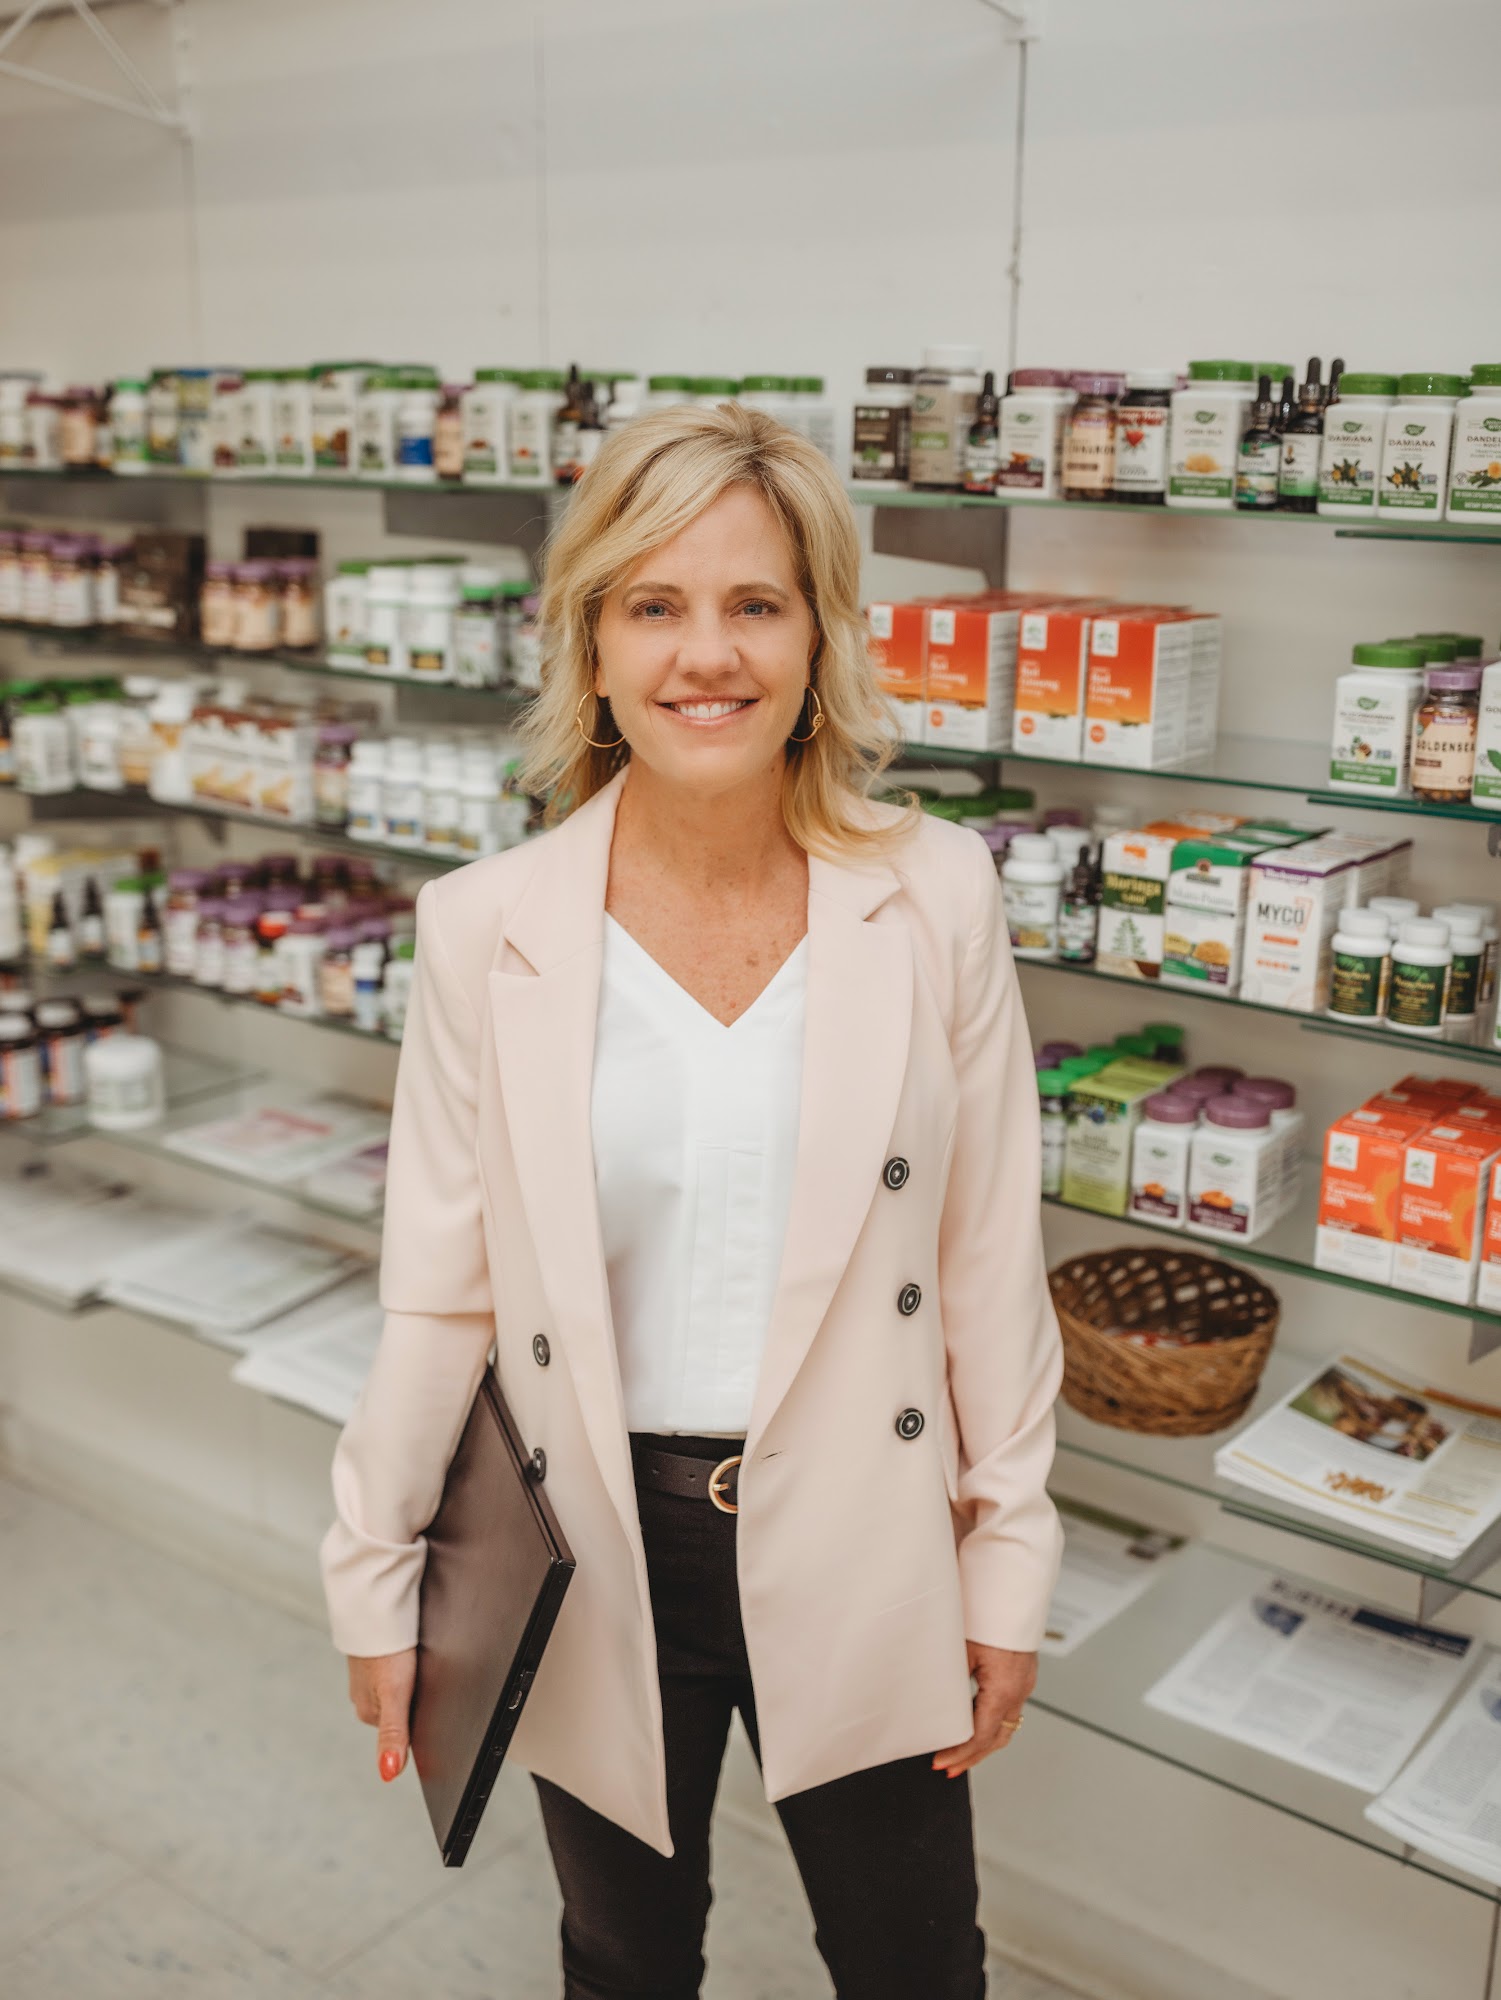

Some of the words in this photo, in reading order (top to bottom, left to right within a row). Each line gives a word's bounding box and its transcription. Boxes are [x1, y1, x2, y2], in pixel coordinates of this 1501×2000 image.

[1328, 434, 1373, 443] DAMIANA
[1388, 440, 1436, 448] DAMIANA
[1106, 873, 1161, 897] Moringa
[1257, 902, 1304, 925] MYCO
